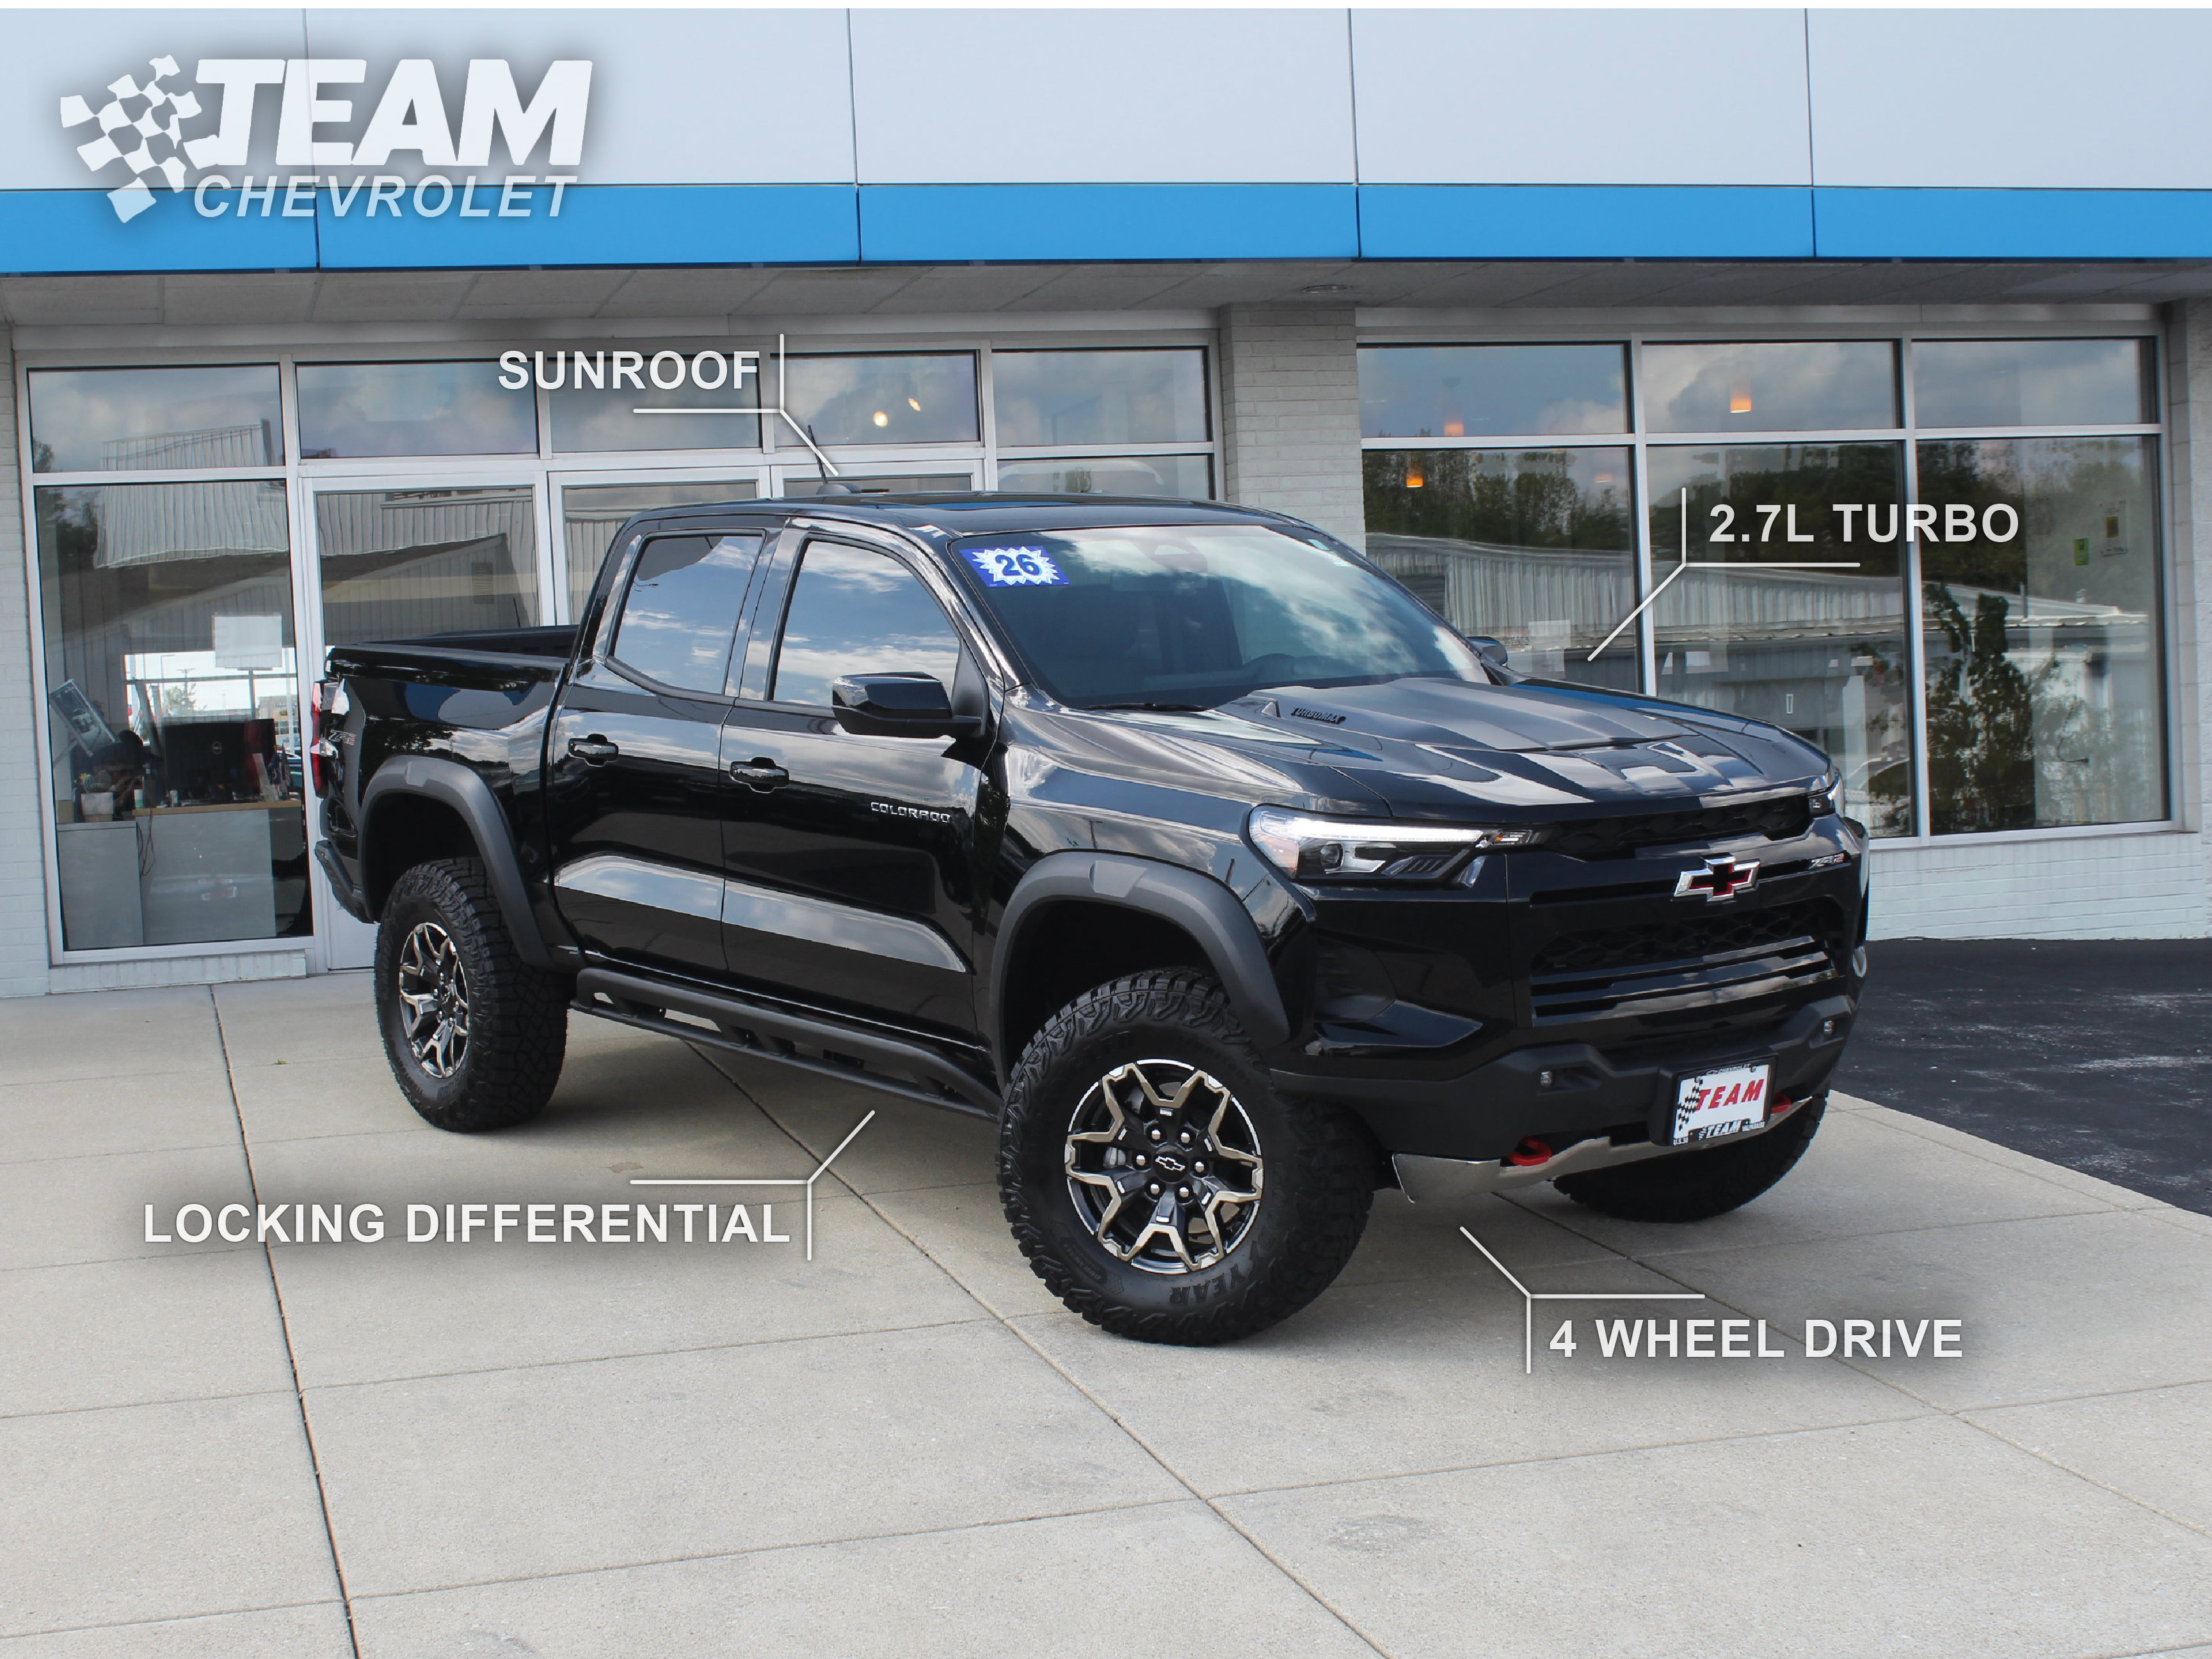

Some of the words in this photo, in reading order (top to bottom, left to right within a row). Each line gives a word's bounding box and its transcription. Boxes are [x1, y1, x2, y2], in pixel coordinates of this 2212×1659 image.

[995, 554, 1043, 576] 26
[870, 801, 951, 824] COLORADO
[1695, 1078, 1765, 1111] TEAM
[1705, 1119, 1742, 1139] TEAM
